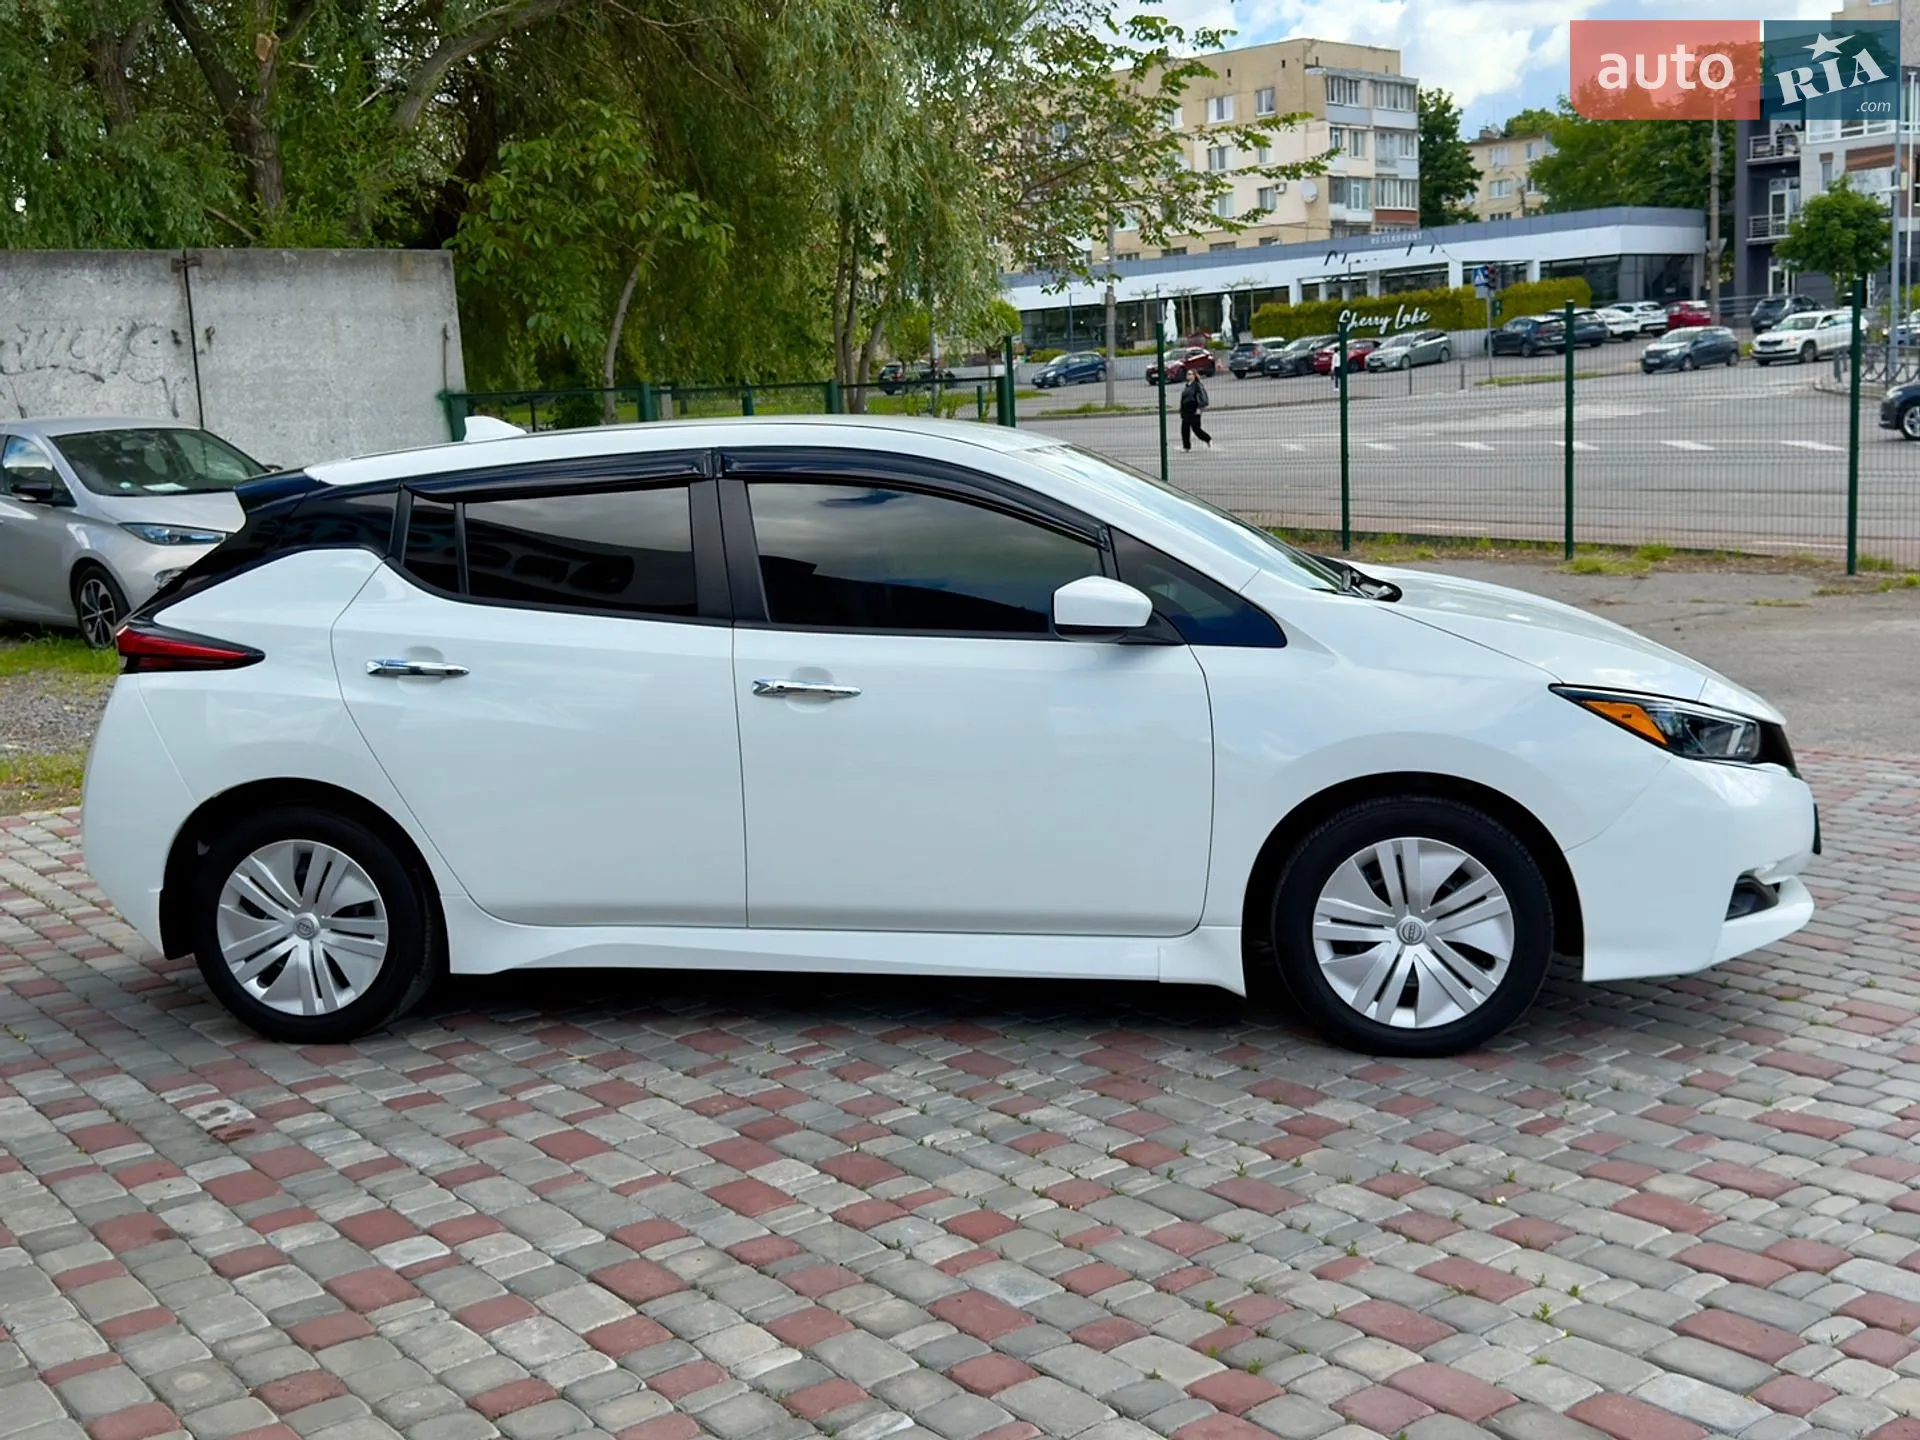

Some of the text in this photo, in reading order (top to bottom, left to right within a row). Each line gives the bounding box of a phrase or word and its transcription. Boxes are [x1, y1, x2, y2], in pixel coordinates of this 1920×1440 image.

[1370, 231, 1423, 245] RESTAURANT
[1338, 303, 1432, 335] Cherry Lake
